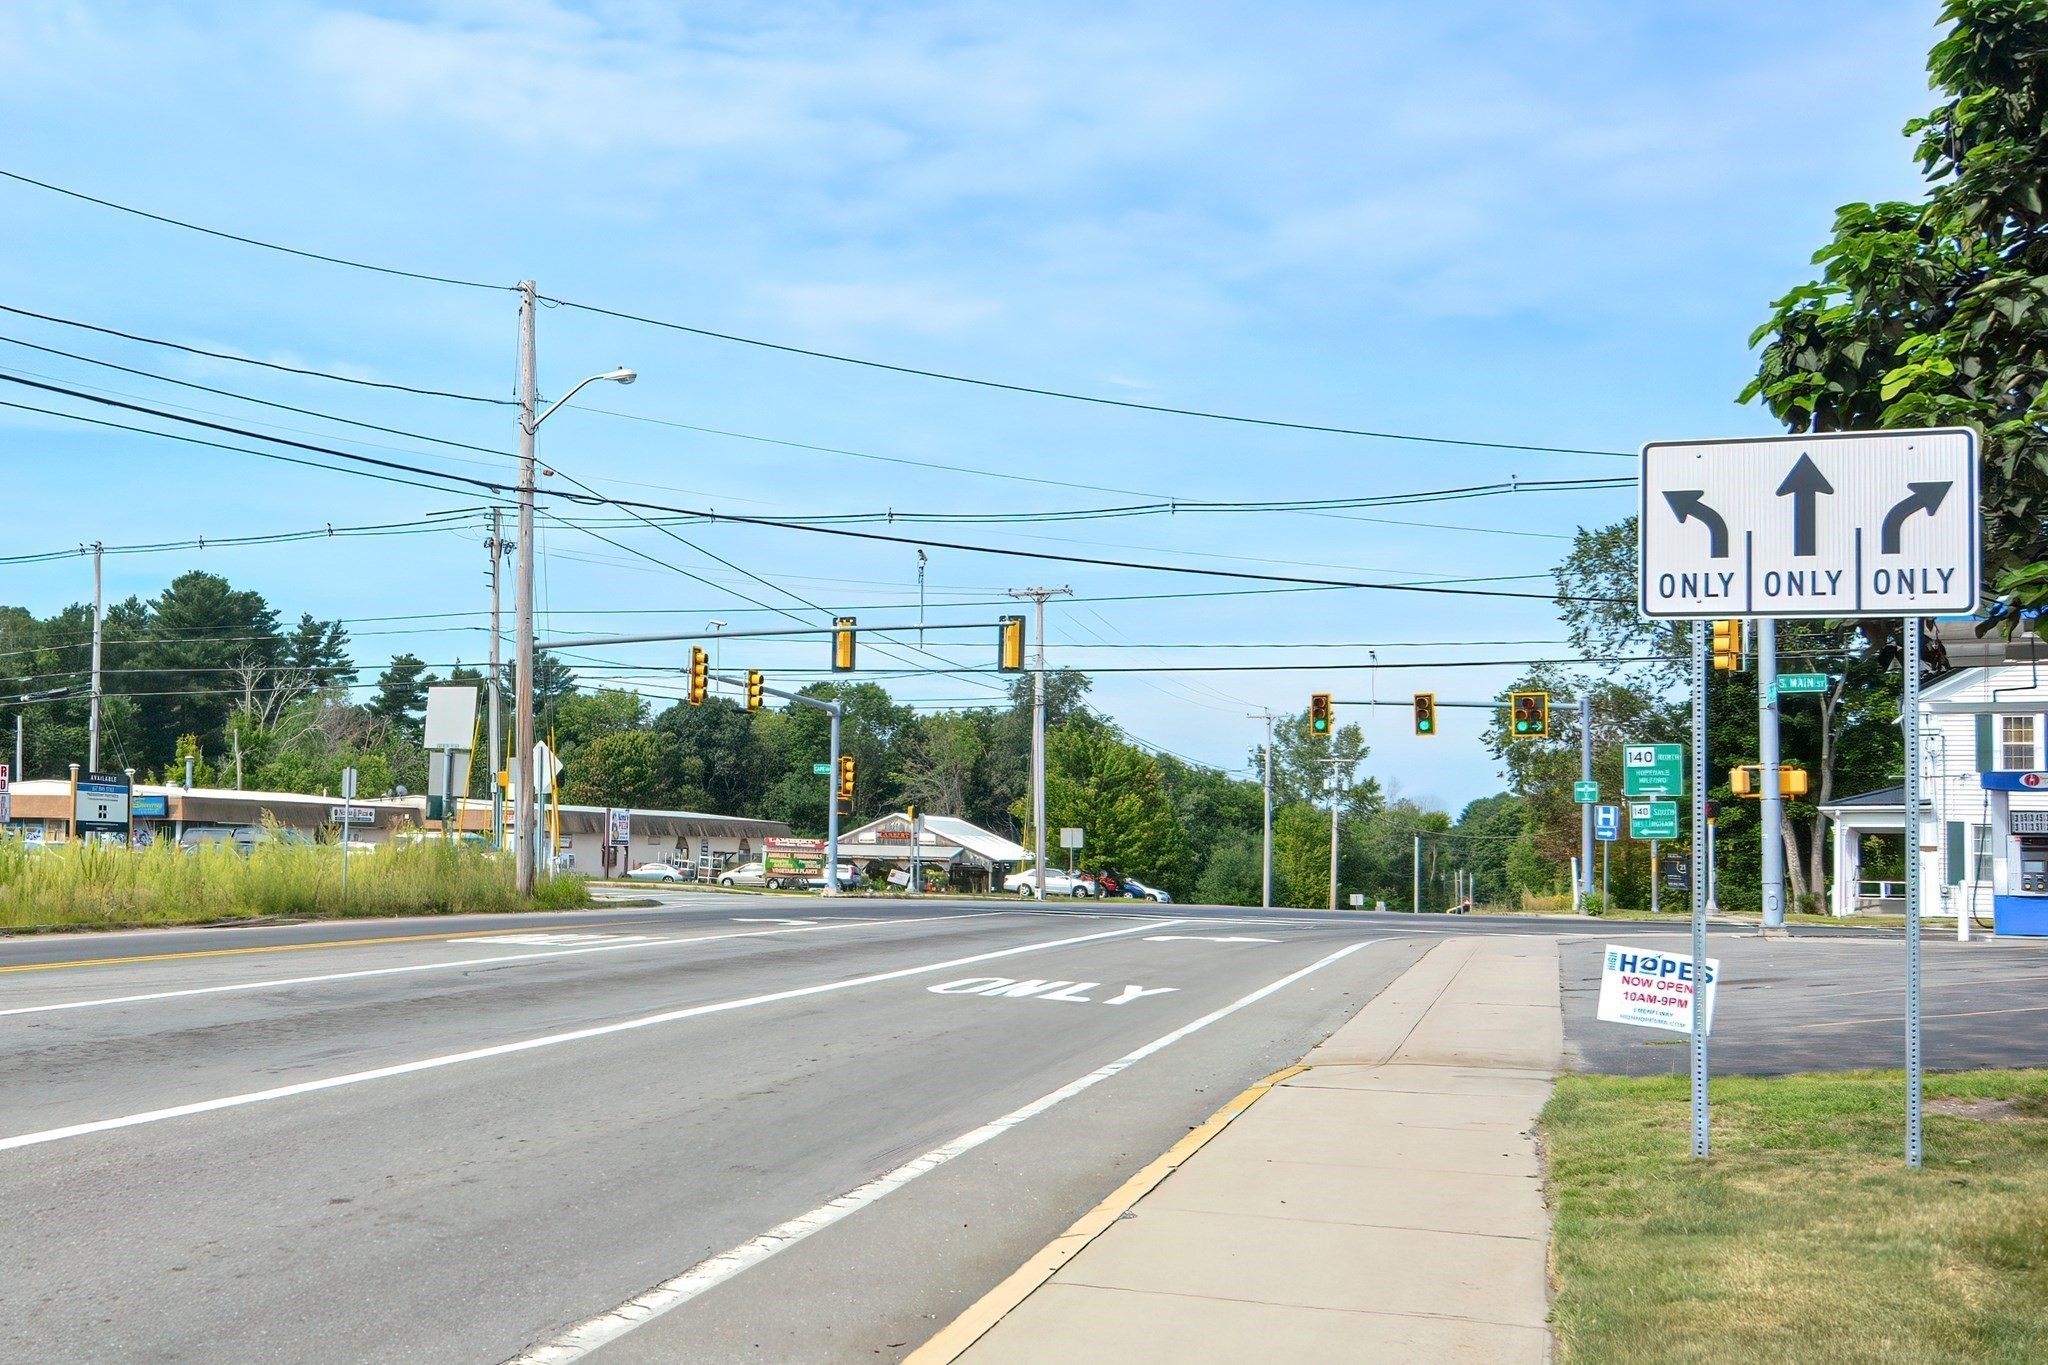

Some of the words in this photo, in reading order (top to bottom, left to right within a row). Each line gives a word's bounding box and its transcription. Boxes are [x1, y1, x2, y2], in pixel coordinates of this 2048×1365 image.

[1659, 572, 1734, 598] ONLY
[1764, 569, 1842, 597] ONLY
[1873, 567, 1954, 595] ONLY
[1790, 678, 1813, 688] MAIN
[1628, 751, 1653, 763] 140
[90, 775, 117, 783] AVAILABLE
[1598, 807, 1614, 825] H
[1634, 808, 1649, 816] 140
[1620, 953, 1714, 984] HOPES
[926, 977, 1181, 1005] ONLY
[1621, 976, 1653, 988] NOW
[1657, 981, 1694, 995] OPEN
[1623, 991, 1688, 1008] 10AM-9PM
